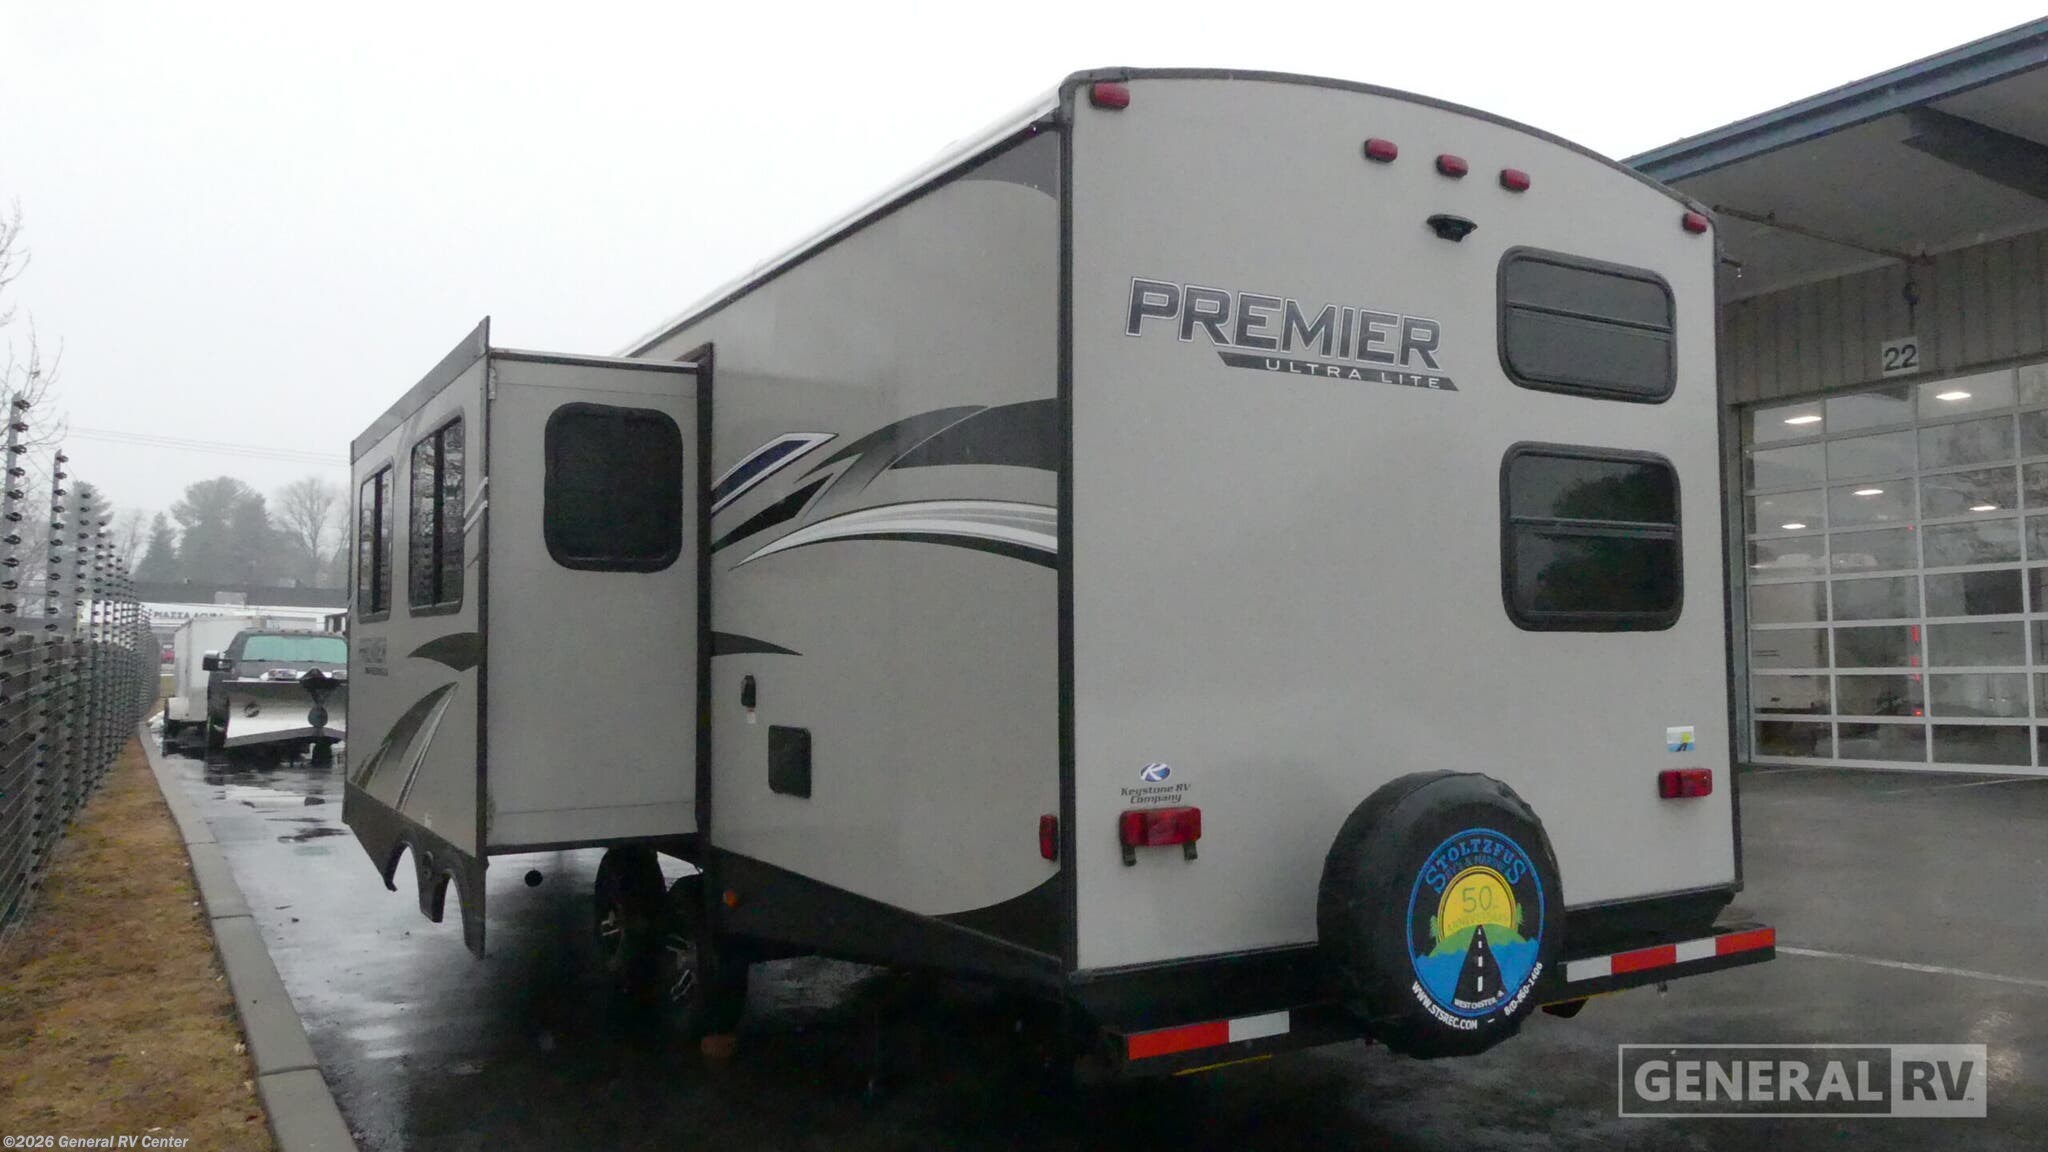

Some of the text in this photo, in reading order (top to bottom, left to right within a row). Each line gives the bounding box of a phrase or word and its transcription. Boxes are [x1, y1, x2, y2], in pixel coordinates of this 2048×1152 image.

[1126, 277, 1442, 370] PREMIER
[1884, 344, 1917, 371] 22
[1266, 359, 1440, 388] ULTRA LITE
[1121, 783, 1191, 797] Keystone RV
[1130, 794, 1182, 804] Company
[1425, 839, 1527, 894] STOLTZFUS
[1462, 886, 1492, 913] 50
